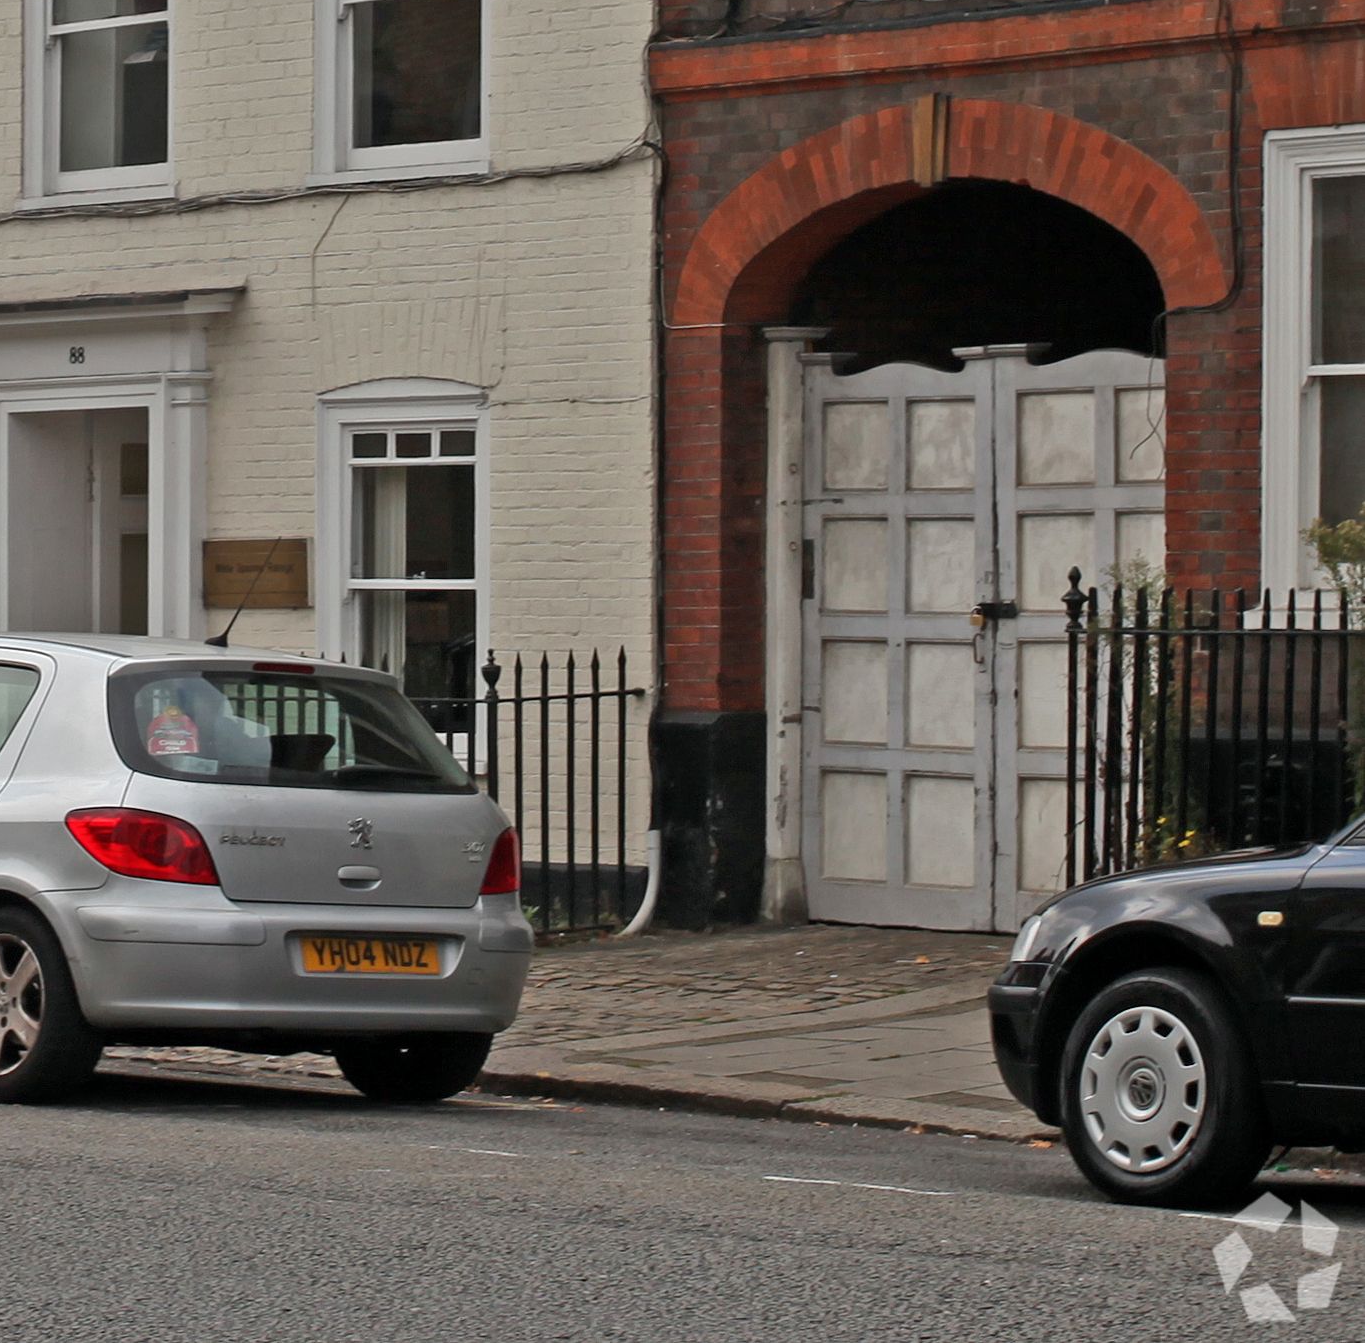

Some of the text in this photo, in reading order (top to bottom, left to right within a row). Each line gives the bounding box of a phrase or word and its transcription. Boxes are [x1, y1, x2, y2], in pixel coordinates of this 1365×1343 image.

[69, 346, 85, 364] 88
[312, 939, 429, 968] YH04 NDZ
